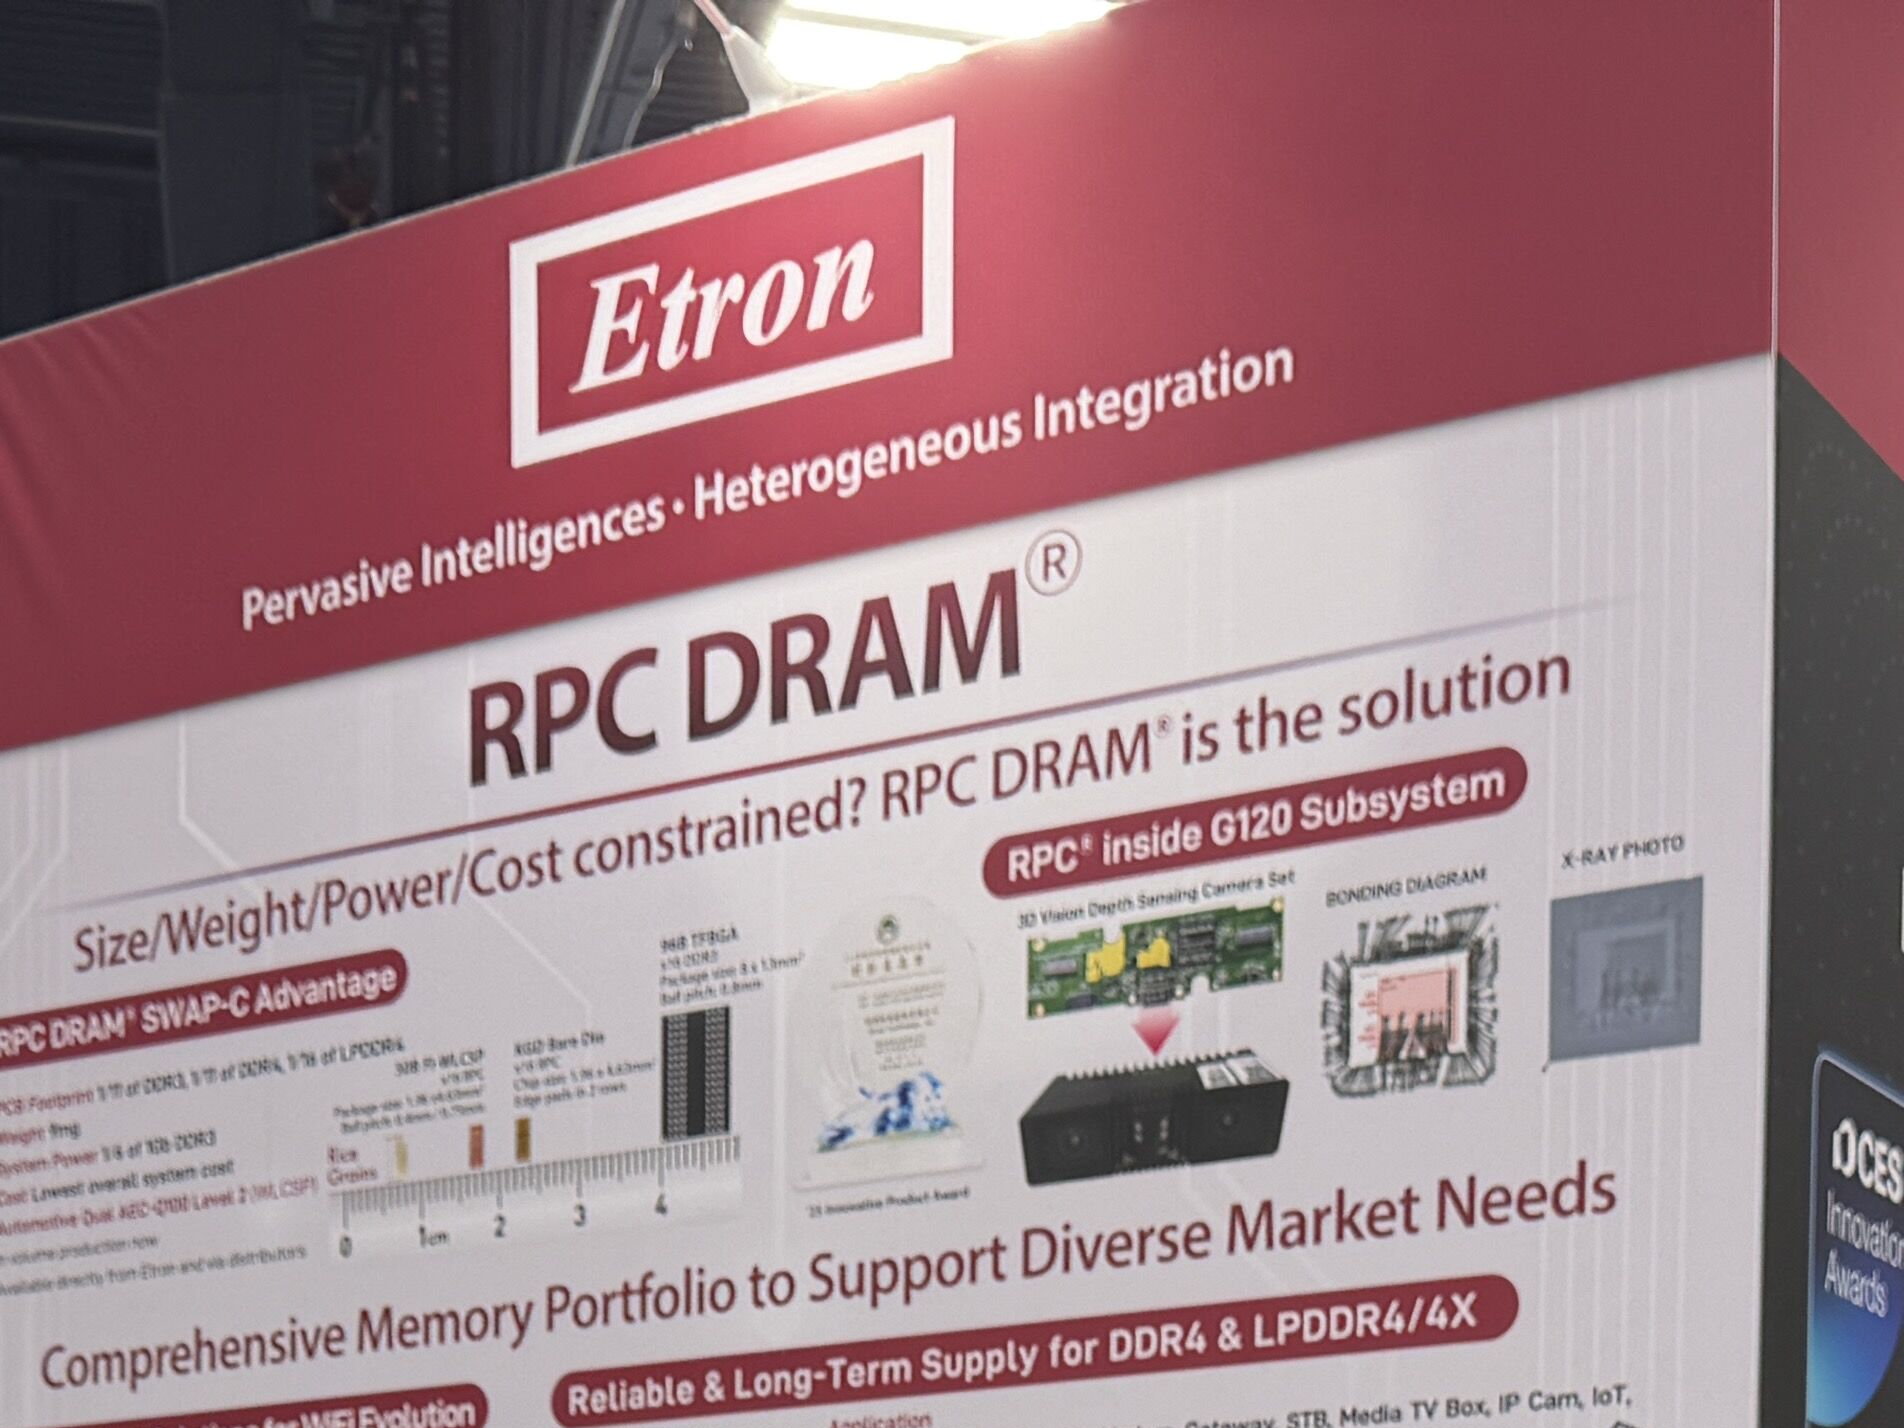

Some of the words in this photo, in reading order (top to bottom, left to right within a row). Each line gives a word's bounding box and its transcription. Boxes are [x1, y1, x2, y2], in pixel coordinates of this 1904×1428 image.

[569, 238, 876, 394] Etron
[242, 553, 414, 632] Pervasive
[421, 494, 666, 588] Intelligences
[694, 412, 1022, 519] Heterogeneous
[1032, 344, 1296, 443] Integration
[468, 647, 659, 788] RPC
[72, 838, 563, 973] Size/Weight/Power/Cost
[574, 776, 866, 878] constrained?
[882, 755, 978, 822] RPC
[1180, 712, 1219, 766] is
[1234, 692, 1324, 755] the
[1338, 653, 1572, 734] solution
[1101, 814, 1203, 864] inside
[1210, 798, 1293, 848] G120
[1299, 767, 1506, 836] Subsystem
[1561, 845, 1618, 869] X-RAY
[1621, 833, 1685, 860] PHOTO
[1326, 881, 1404, 909] BONDING
[1406, 866, 1487, 896] DIAGRAM
[141, 984, 251, 1035] SWAP-C
[254, 963, 398, 1015] Advantage
[39, 1316, 346, 1397] Comprehensive
[356, 1298, 535, 1354] Memory
[546, 1269, 736, 1332] Portfolio
[750, 1260, 796, 1310] to
[808, 1233, 1008, 1314] Support
[1019, 1210, 1212, 1278] Diverse
[1225, 1186, 1419, 1257] Market
[1435, 1158, 1619, 1230] Needs
[1823, 1248, 1890, 1319] Awards
[566, 1373, 695, 1417] Reliable
[703, 1370, 727, 1403] &
[734, 1351, 912, 1400] Long-Term
[921, 1333, 1040, 1385] Supply
[1048, 1327, 1098, 1368] for
[1107, 1318, 1207, 1364] DDR4
[1217, 1313, 1243, 1352] &
[1254, 1289, 1481, 1348] LPDDR4/4X
[1339, 1402, 1403, 1428] Media
[1412, 1400, 1441, 1422] TV
[1498, 1392, 1521, 1415] IP
